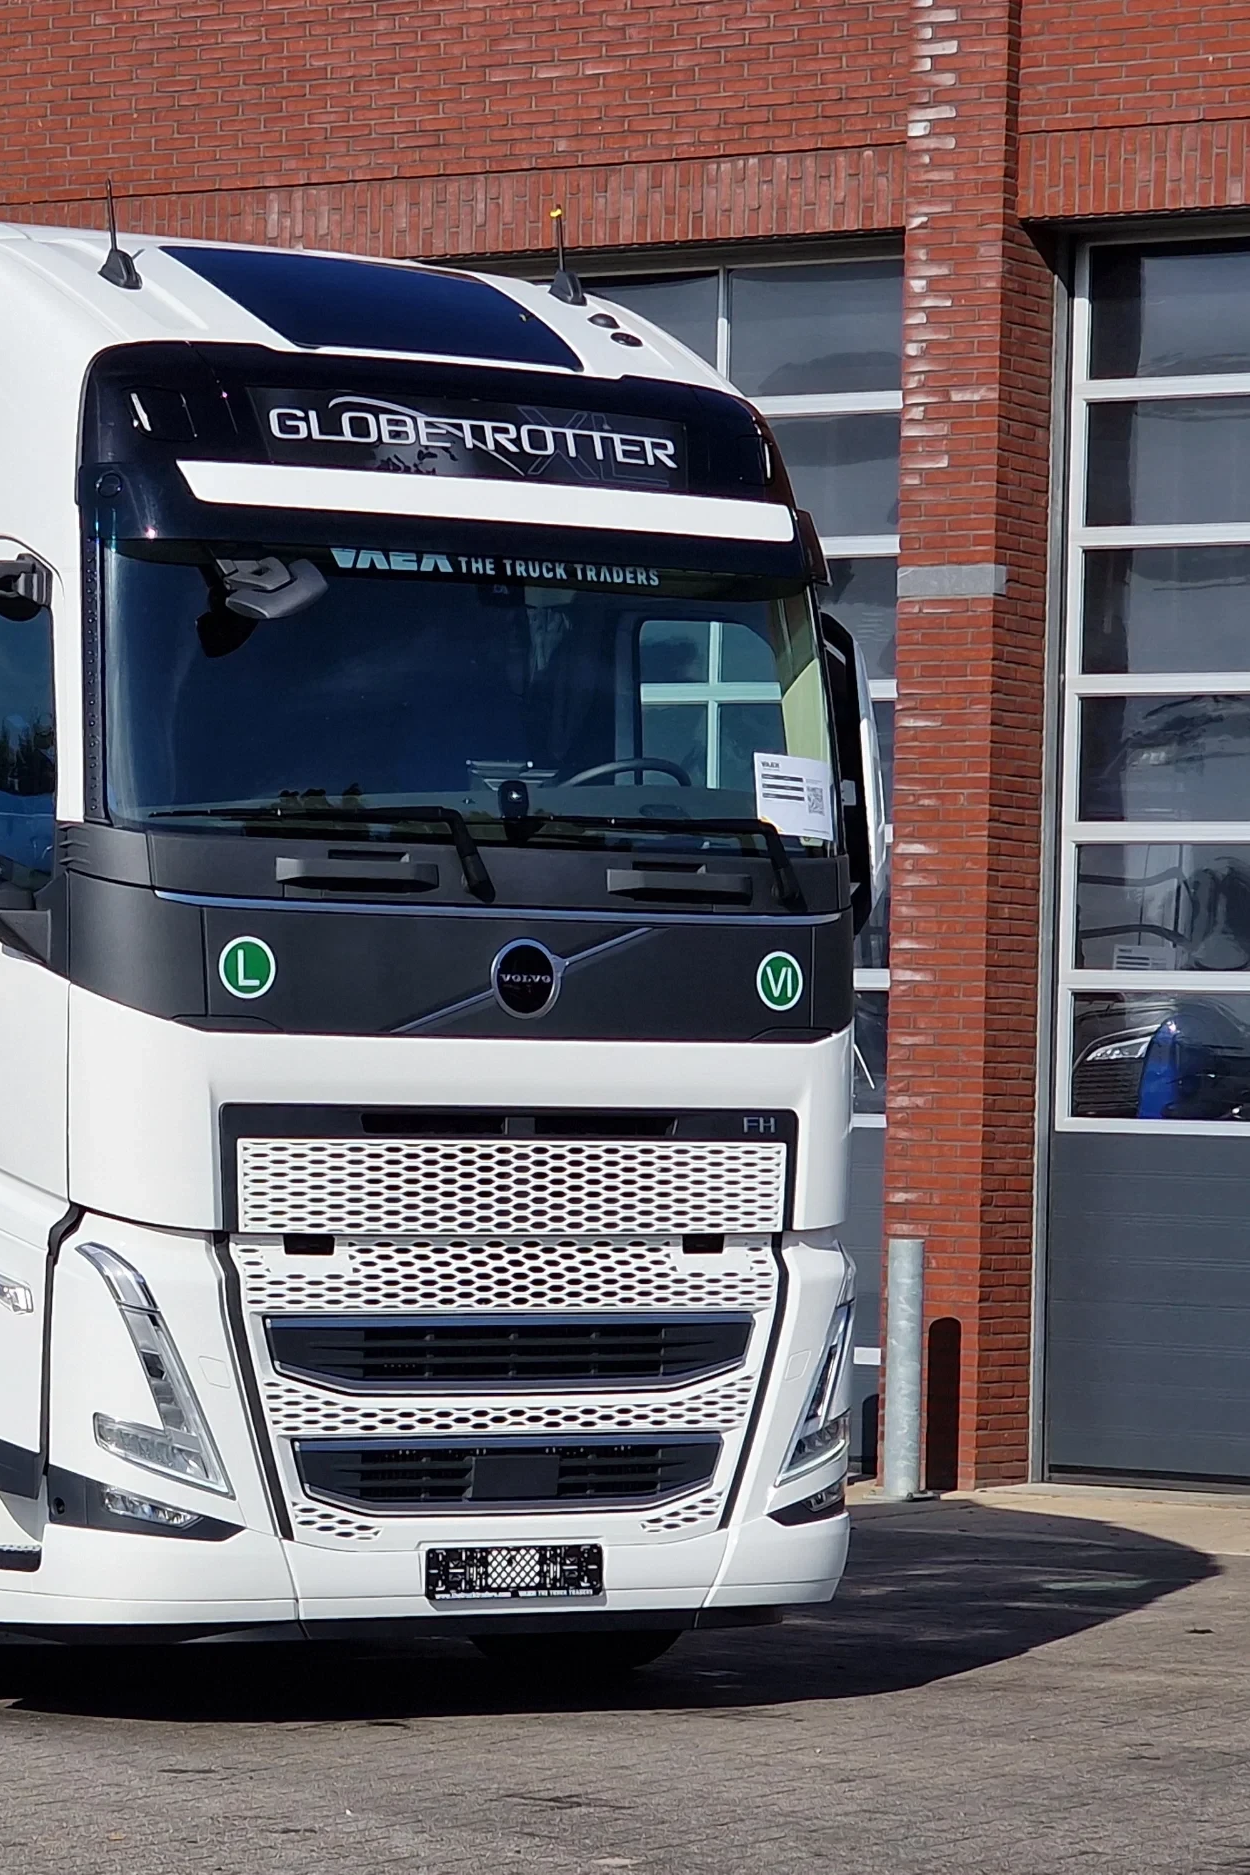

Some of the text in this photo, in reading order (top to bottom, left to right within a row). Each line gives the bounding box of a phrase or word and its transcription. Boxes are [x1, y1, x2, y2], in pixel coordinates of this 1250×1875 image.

[269, 406, 678, 470] GLOBETROTTER
[458, 556, 496, 575] THE
[503, 559, 568, 580] TRUCK
[574, 563, 660, 586] TRADERS
[237, 948, 261, 987] L
[500, 973, 551, 983] VOLVO
[765, 966, 793, 998] VI
[743, 1116, 776, 1134] FH
